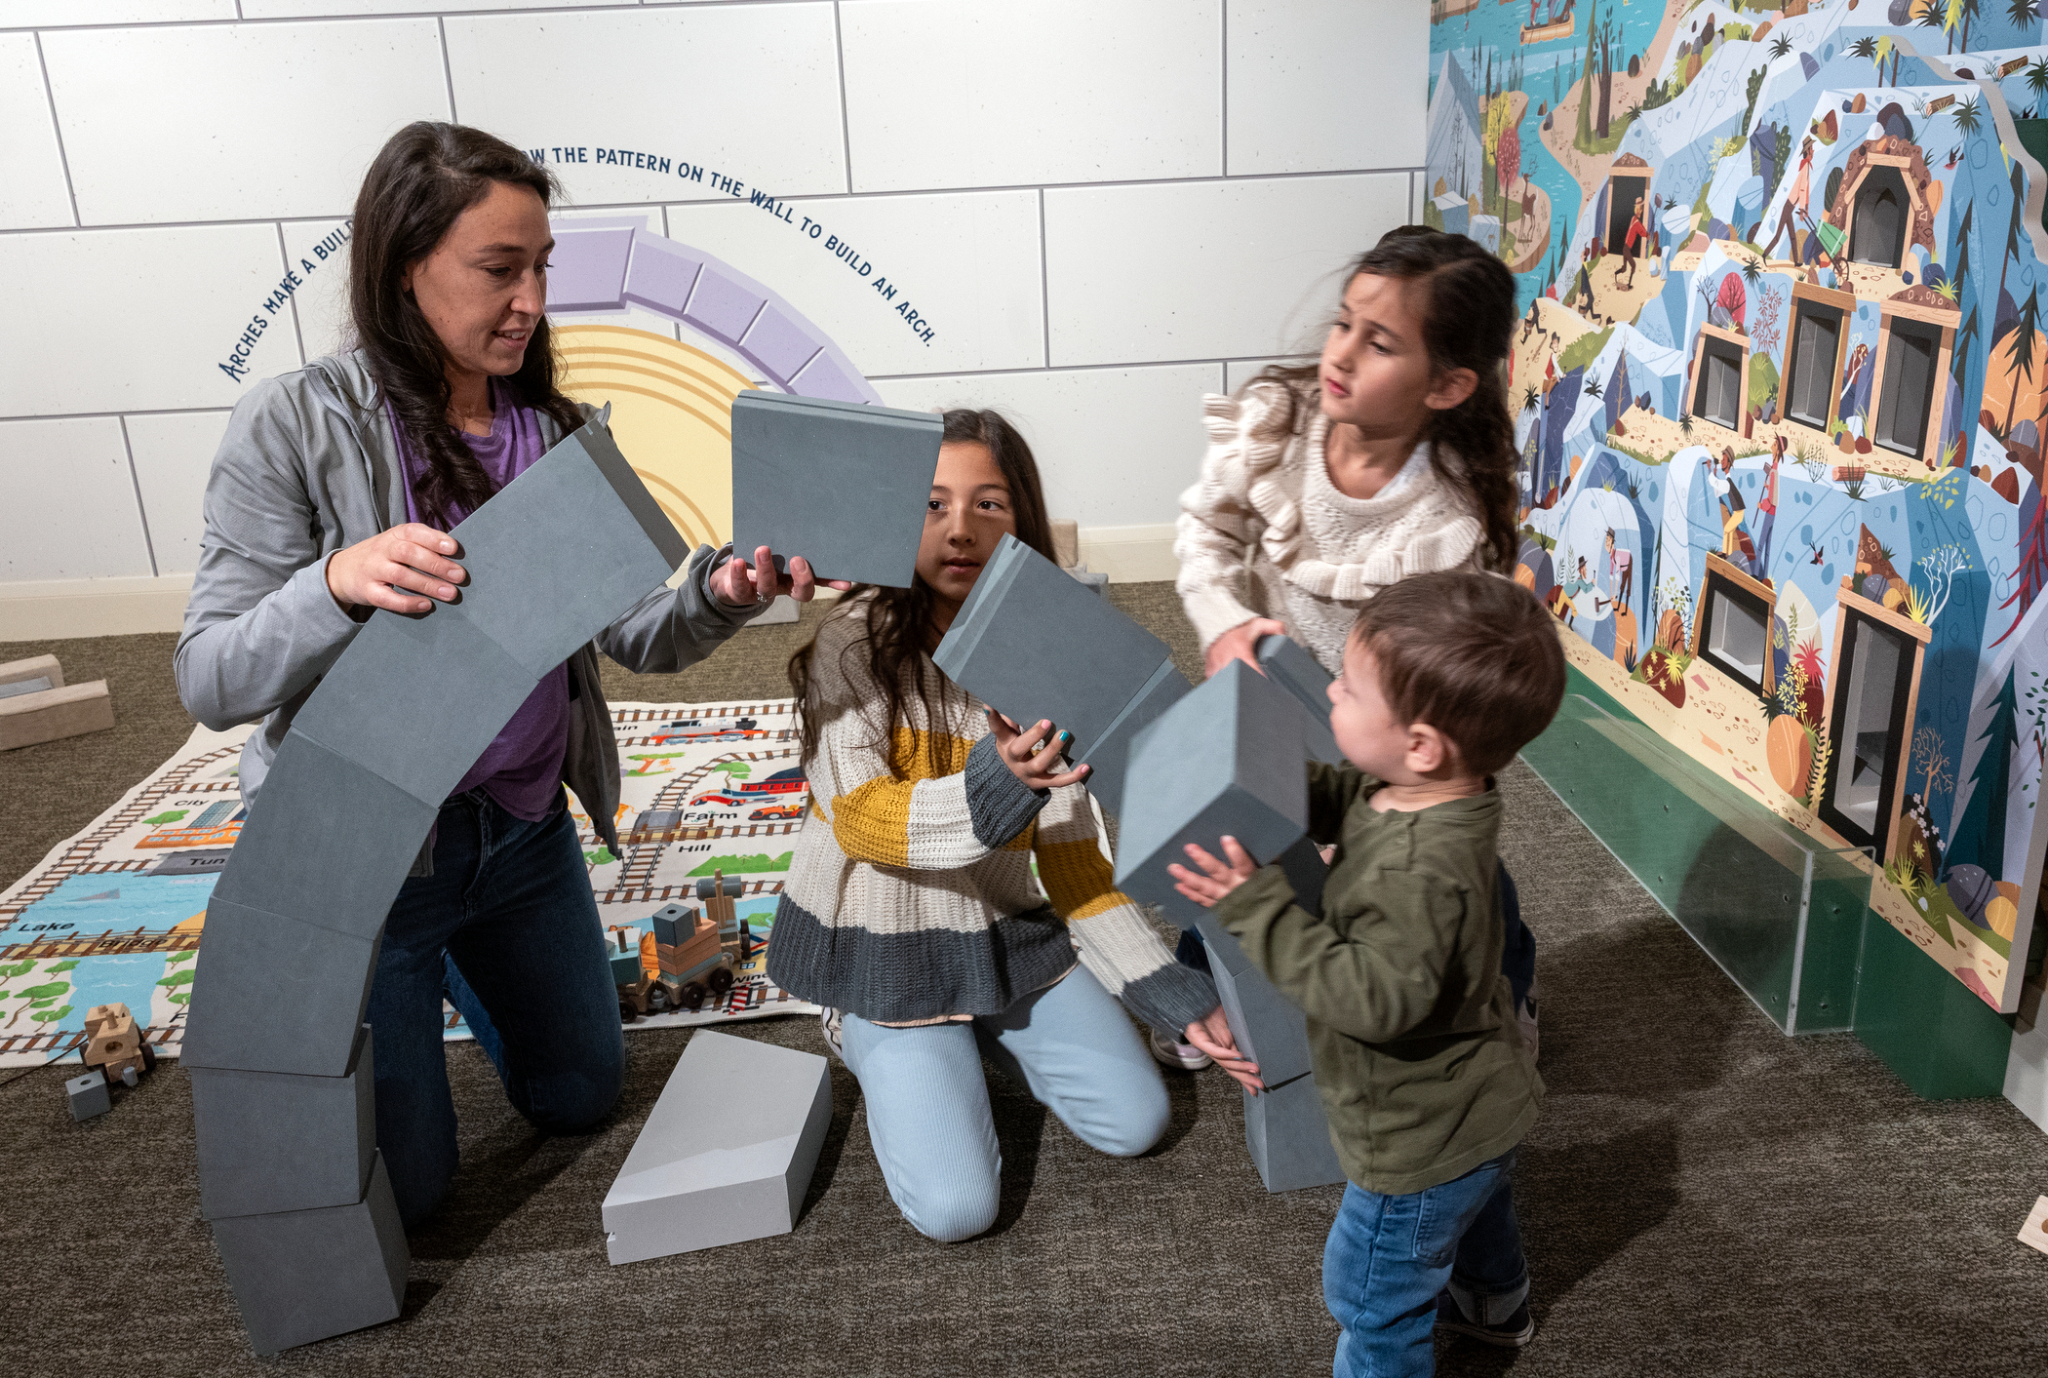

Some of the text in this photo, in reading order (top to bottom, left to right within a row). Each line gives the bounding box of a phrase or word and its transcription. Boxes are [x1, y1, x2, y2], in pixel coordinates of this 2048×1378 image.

[218, 315, 268, 384] ARCHES
[263, 271, 303, 315] MAKE
[301, 258, 316, 274] A
[552, 147, 588, 163] THE
[596, 148, 671, 174] PATTERN
[678, 162, 704, 182] ON
[710, 171, 744, 197] THE
[750, 188, 793, 224] WALL
[800, 216, 822, 239] TO
[824, 234, 872, 277] BUILD
[871, 277, 898, 301] AN
[895, 301, 935, 347] ARCH.
[684, 812, 738, 820] Farm
[678, 844, 711, 852] Hill
[18, 922, 75, 932] Lake
[98, 938, 168, 948] Bridge
